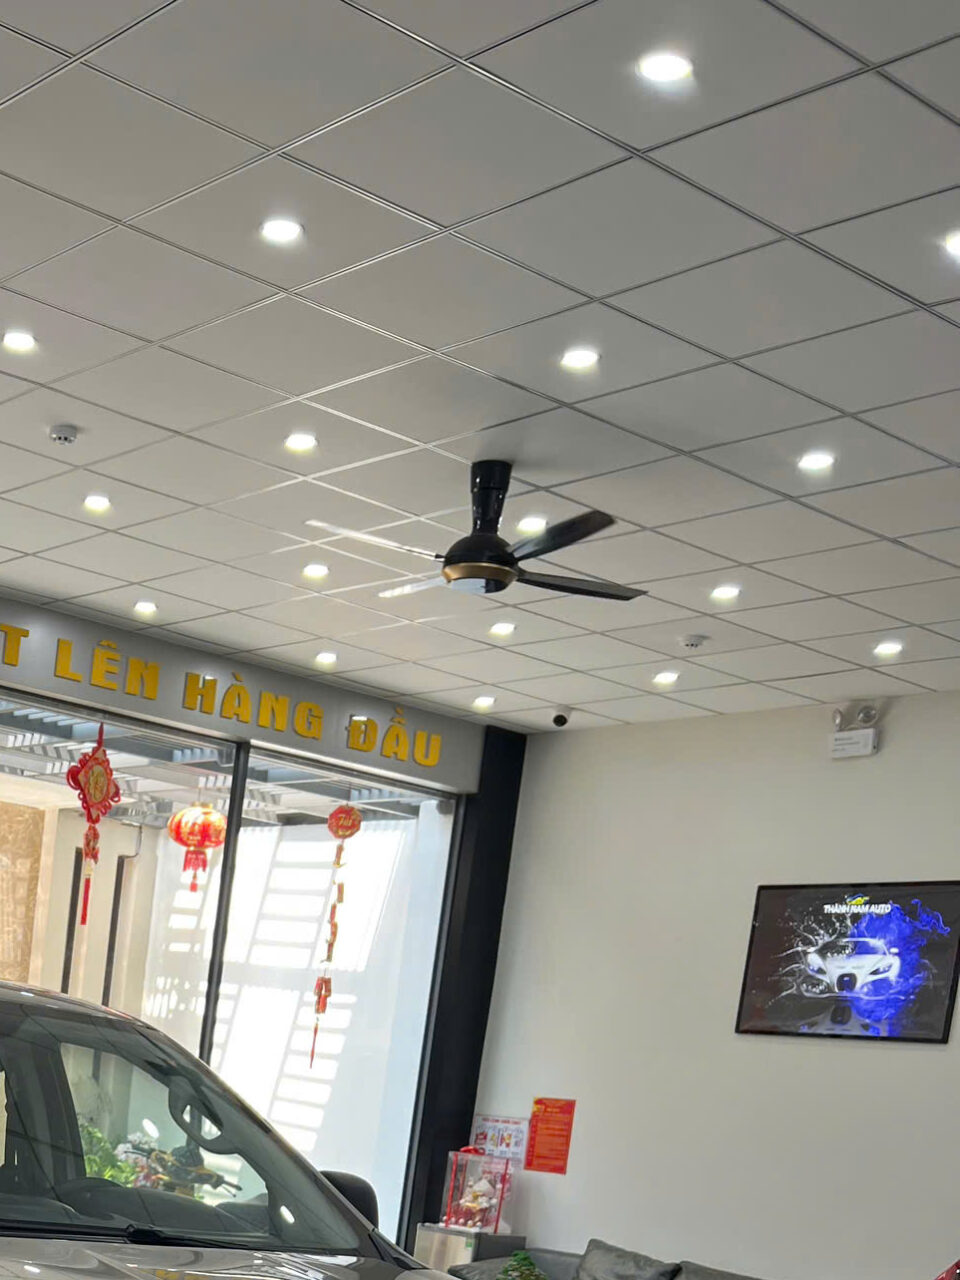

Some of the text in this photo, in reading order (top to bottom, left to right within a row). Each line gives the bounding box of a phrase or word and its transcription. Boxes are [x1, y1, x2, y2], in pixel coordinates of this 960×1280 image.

[54, 638, 161, 701] LÊN
[183, 672, 325, 741] HÀNG
[345, 705, 443, 768] ĐẦU
[869, 903, 891, 914] AUTO
